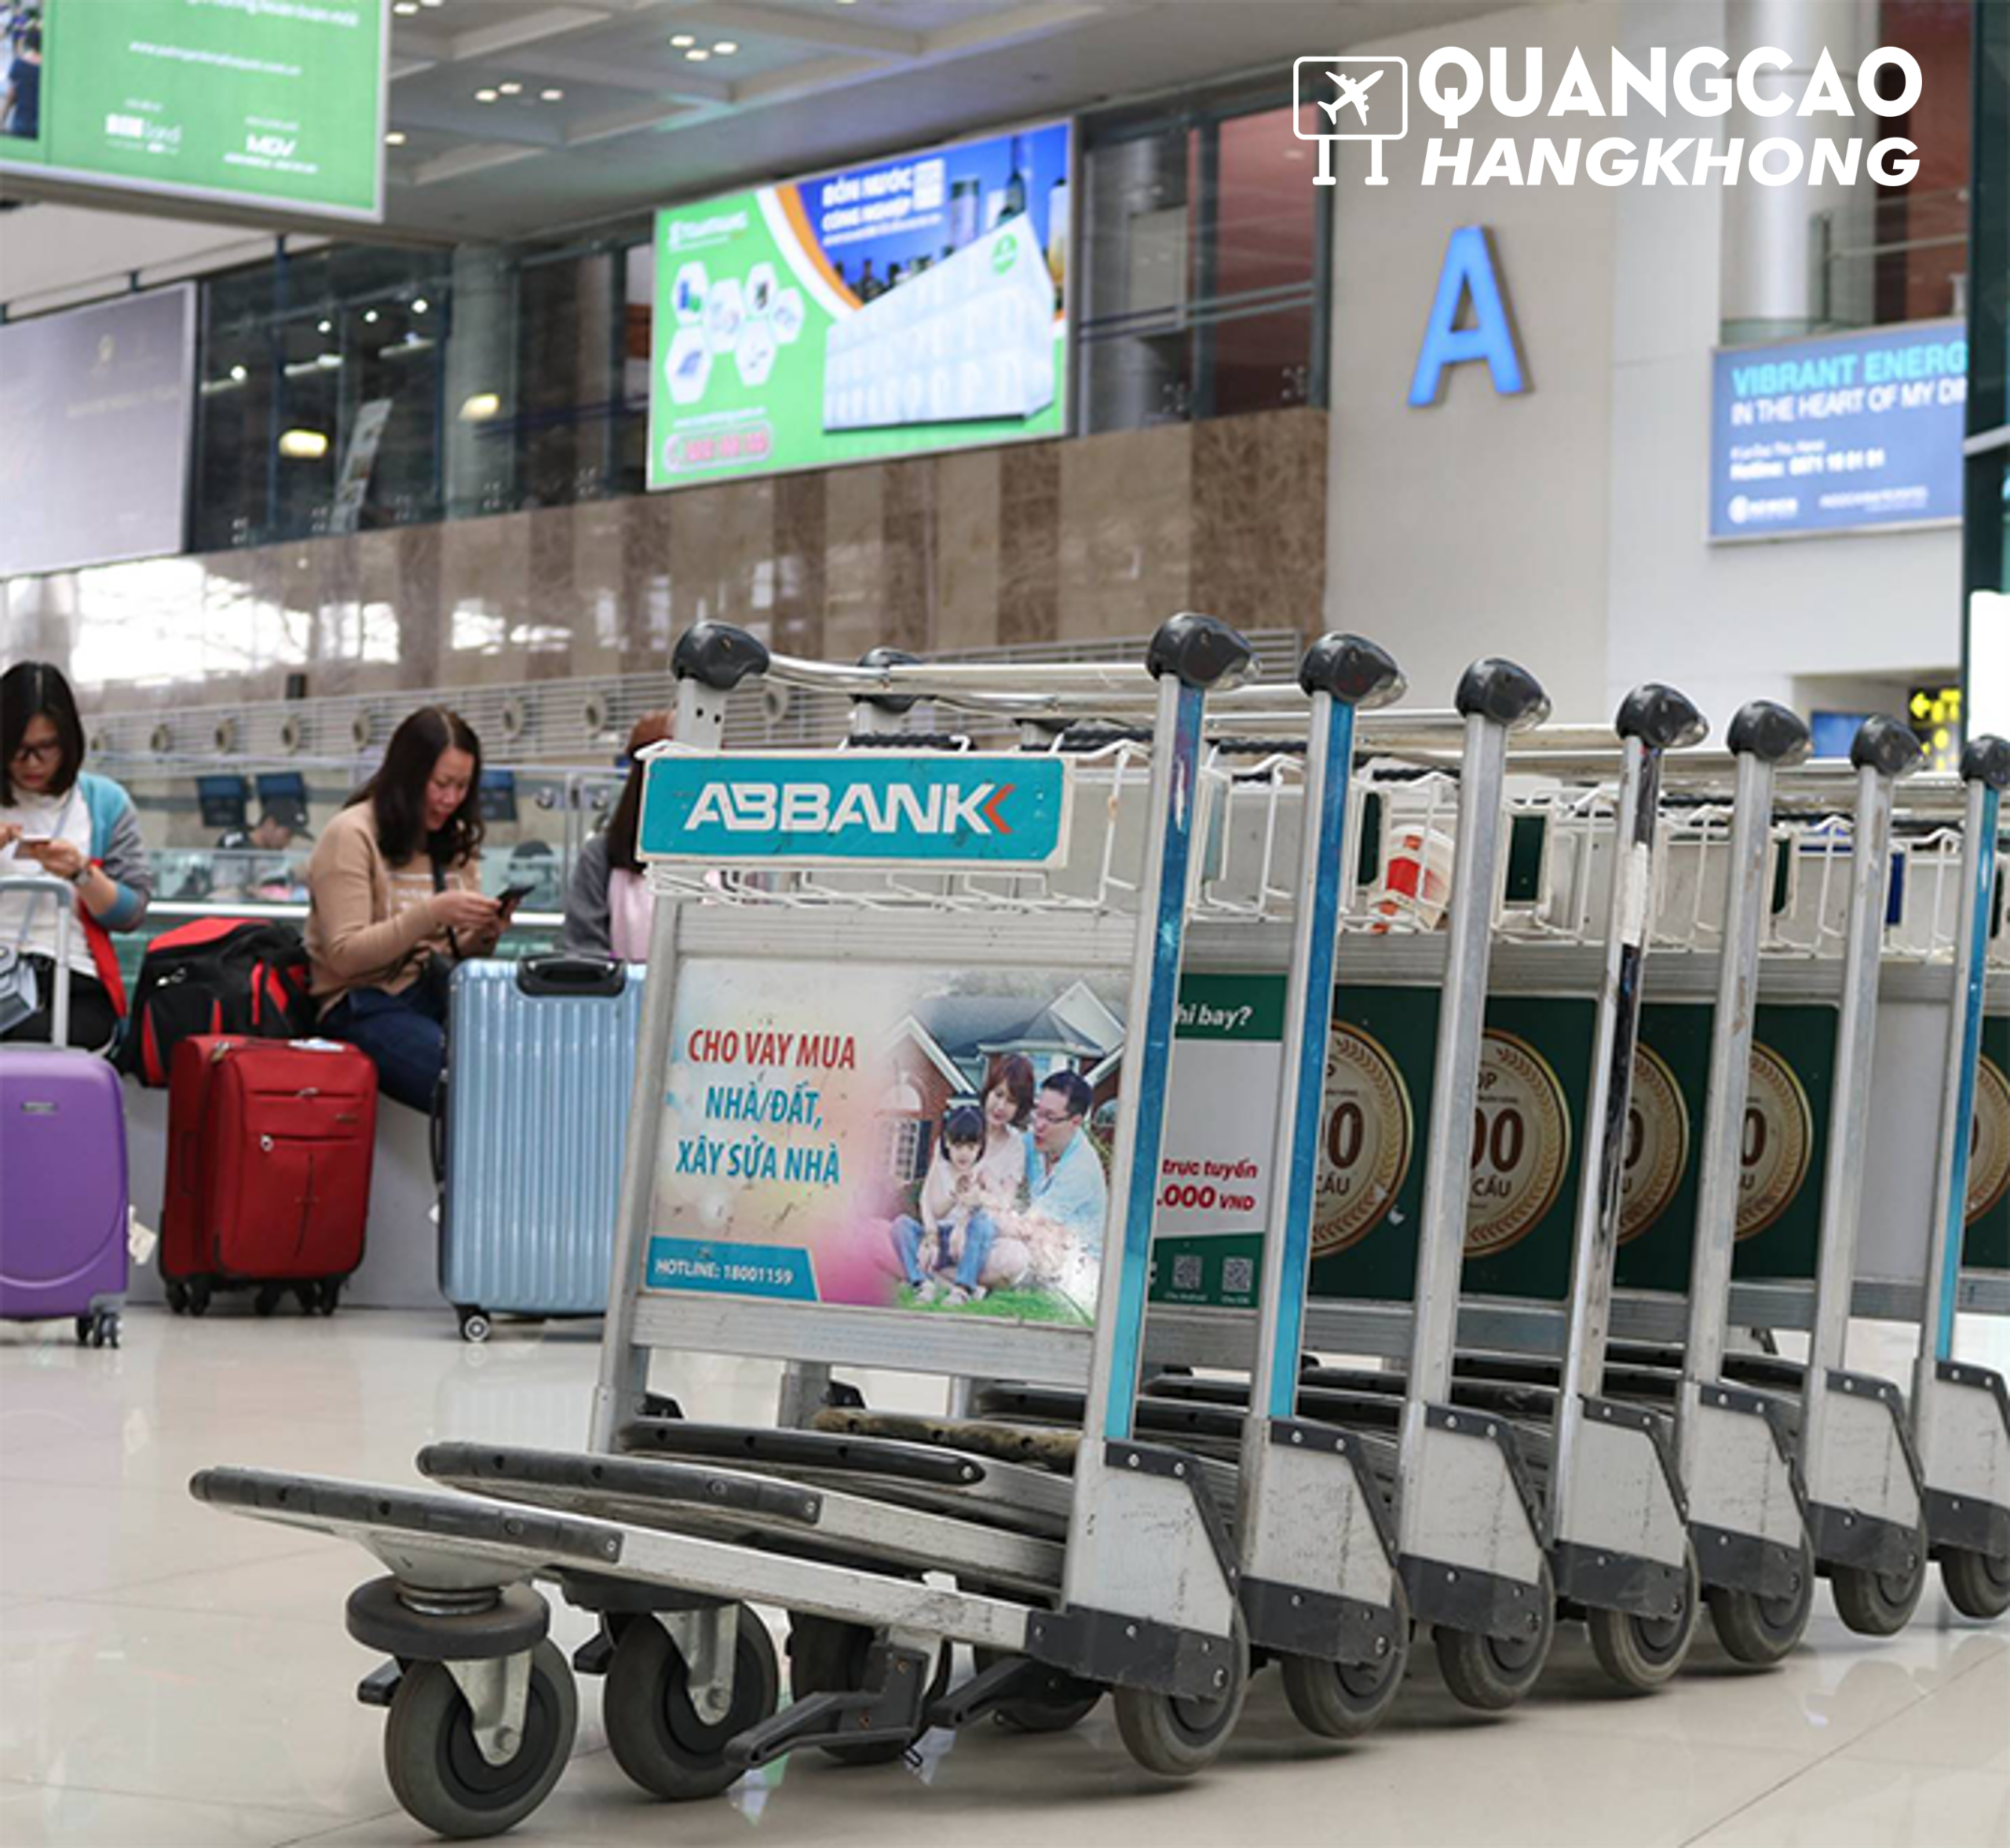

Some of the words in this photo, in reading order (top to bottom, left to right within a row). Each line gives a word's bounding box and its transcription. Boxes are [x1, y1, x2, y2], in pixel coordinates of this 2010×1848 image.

[1408, 225, 1524, 407] A
[1731, 354, 1858, 397] VIBRANT
[1731, 401, 1753, 426] IN
[1756, 396, 1795, 424] THE
[1798, 388, 1865, 419] HEART
[1868, 384, 1899, 412] OF
[1901, 382, 1935, 408] MY
[683, 783, 997, 833] ABBANK
[1198, 1003, 1253, 1030] bay?
[689, 1029, 740, 1065] CHO
[745, 1031, 794, 1067] VAY
[795, 1034, 856, 1070] MUA
[705, 1080, 823, 1130] NHÀ/ĐẤT,
[675, 1135, 722, 1175] XÂY
[727, 1134, 777, 1179] SỬA
[784, 1142, 840, 1185] NHÀ
[655, 1258, 720, 1280] HOTLINE:
[723, 1265, 795, 1285] 18001159
